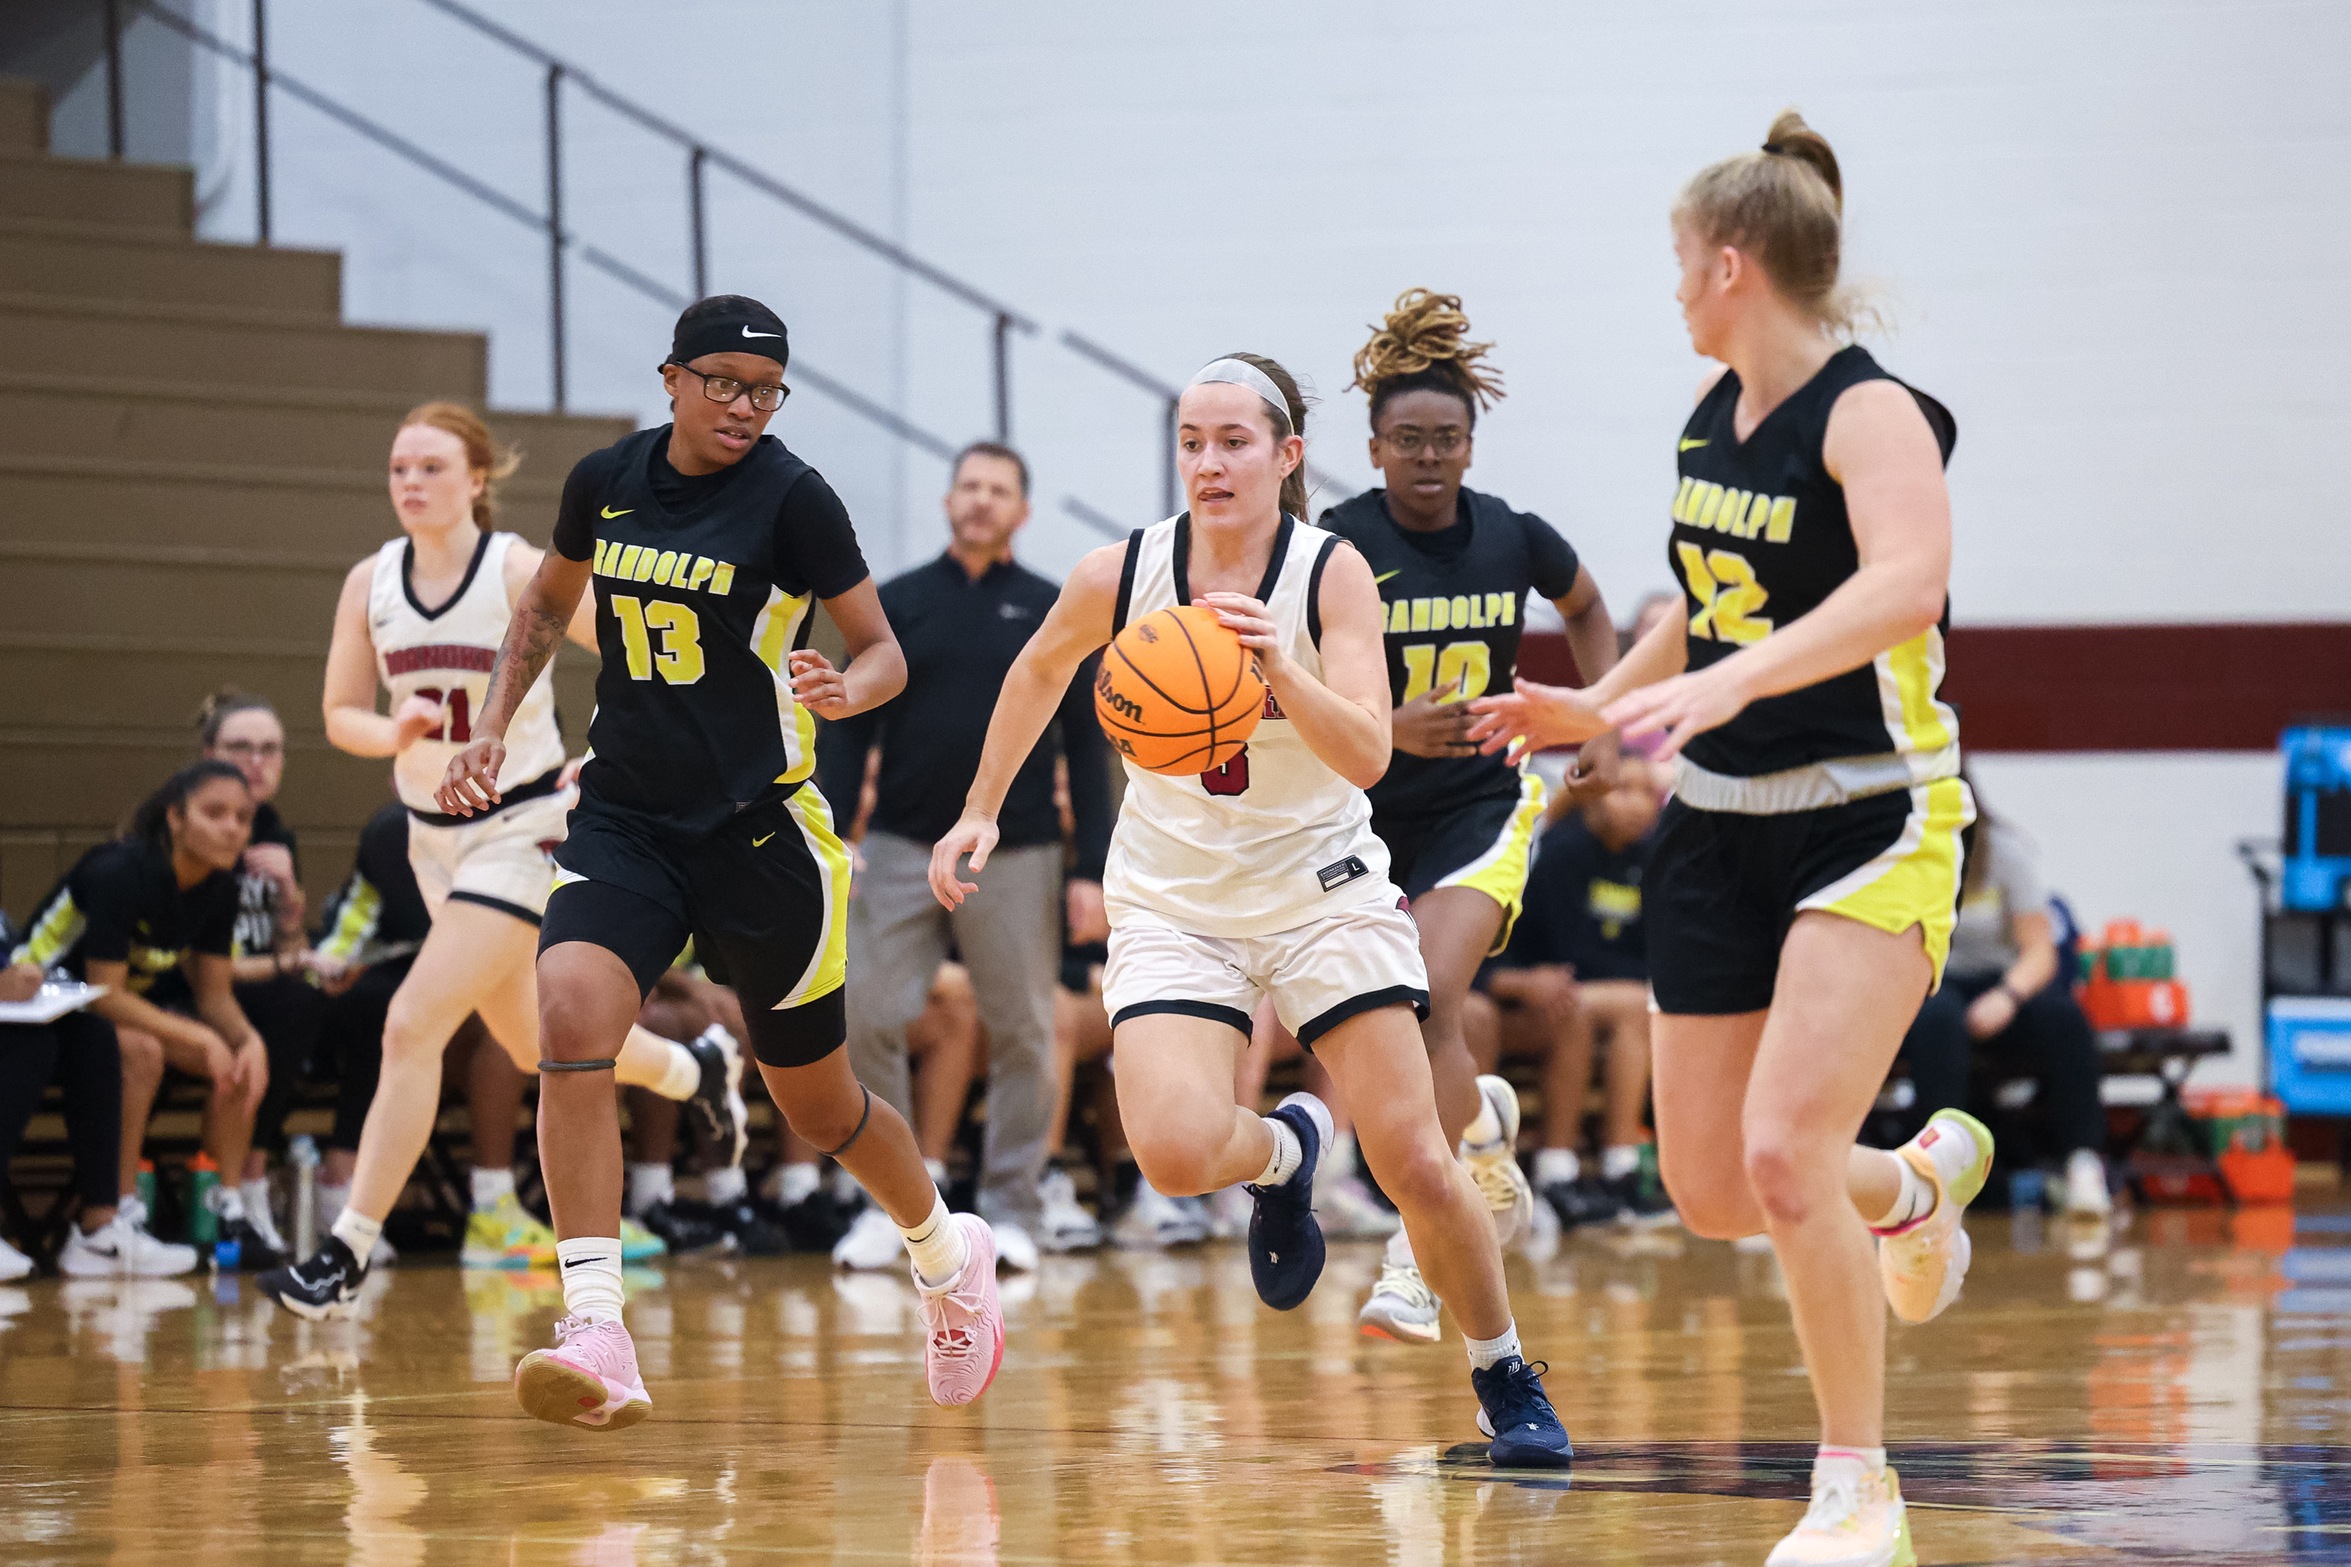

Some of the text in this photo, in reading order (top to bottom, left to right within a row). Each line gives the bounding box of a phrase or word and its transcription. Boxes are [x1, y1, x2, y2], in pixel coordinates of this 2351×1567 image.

[1673, 476, 1797, 544] ANDOLPH
[1676, 540, 1773, 646] 12
[611, 594, 705, 685] 13
[1097, 666, 1146, 724] lson
[1402, 641, 1490, 705] 10
[1351, 862, 1360, 871] L
